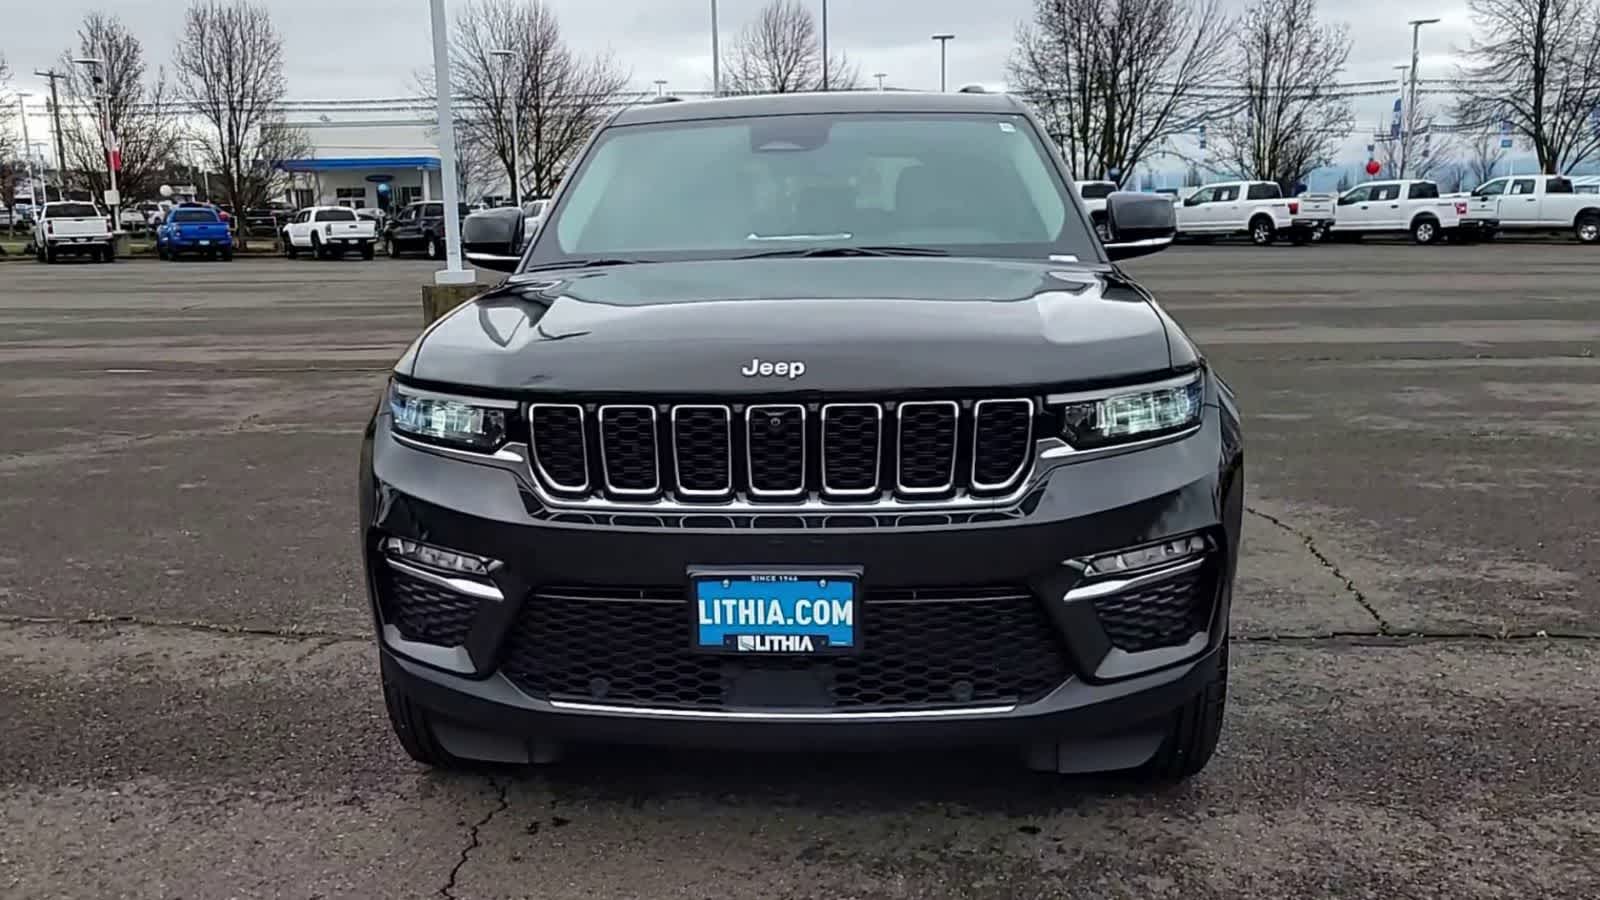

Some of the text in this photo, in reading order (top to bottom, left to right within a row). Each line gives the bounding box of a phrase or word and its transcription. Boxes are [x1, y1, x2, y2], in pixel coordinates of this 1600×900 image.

[742, 359, 805, 379] Jeep
[699, 599, 853, 626] LITHIA.COM
[755, 635, 814, 652] LITHIA
